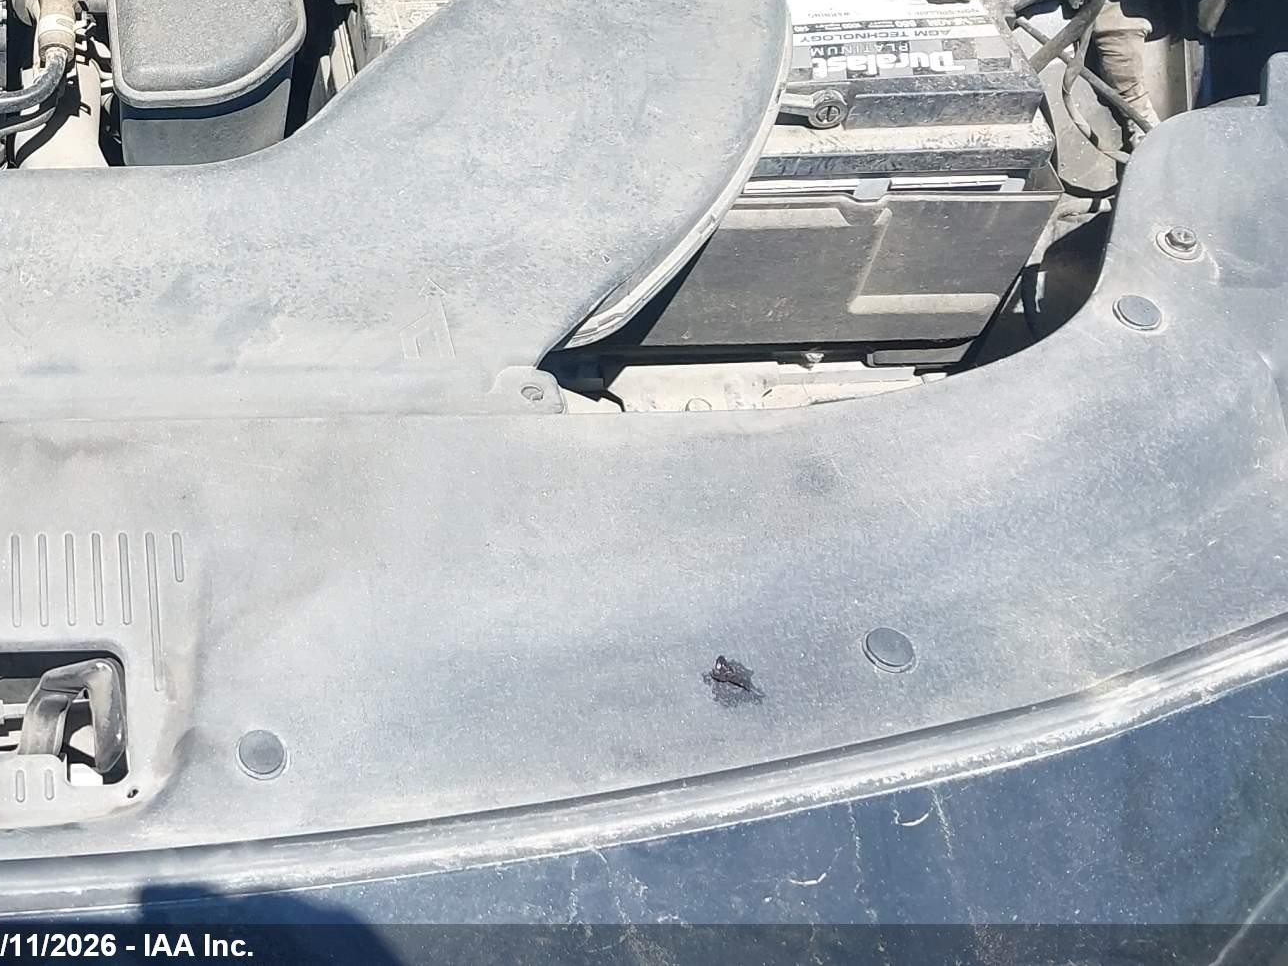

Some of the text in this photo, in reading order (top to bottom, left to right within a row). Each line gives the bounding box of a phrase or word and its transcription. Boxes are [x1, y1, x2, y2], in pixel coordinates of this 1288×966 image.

[800, 28, 953, 43] AGM TECHNOLOGY
[810, 41, 909, 57] PLATINUM
[811, 51, 966, 80] Duralast
